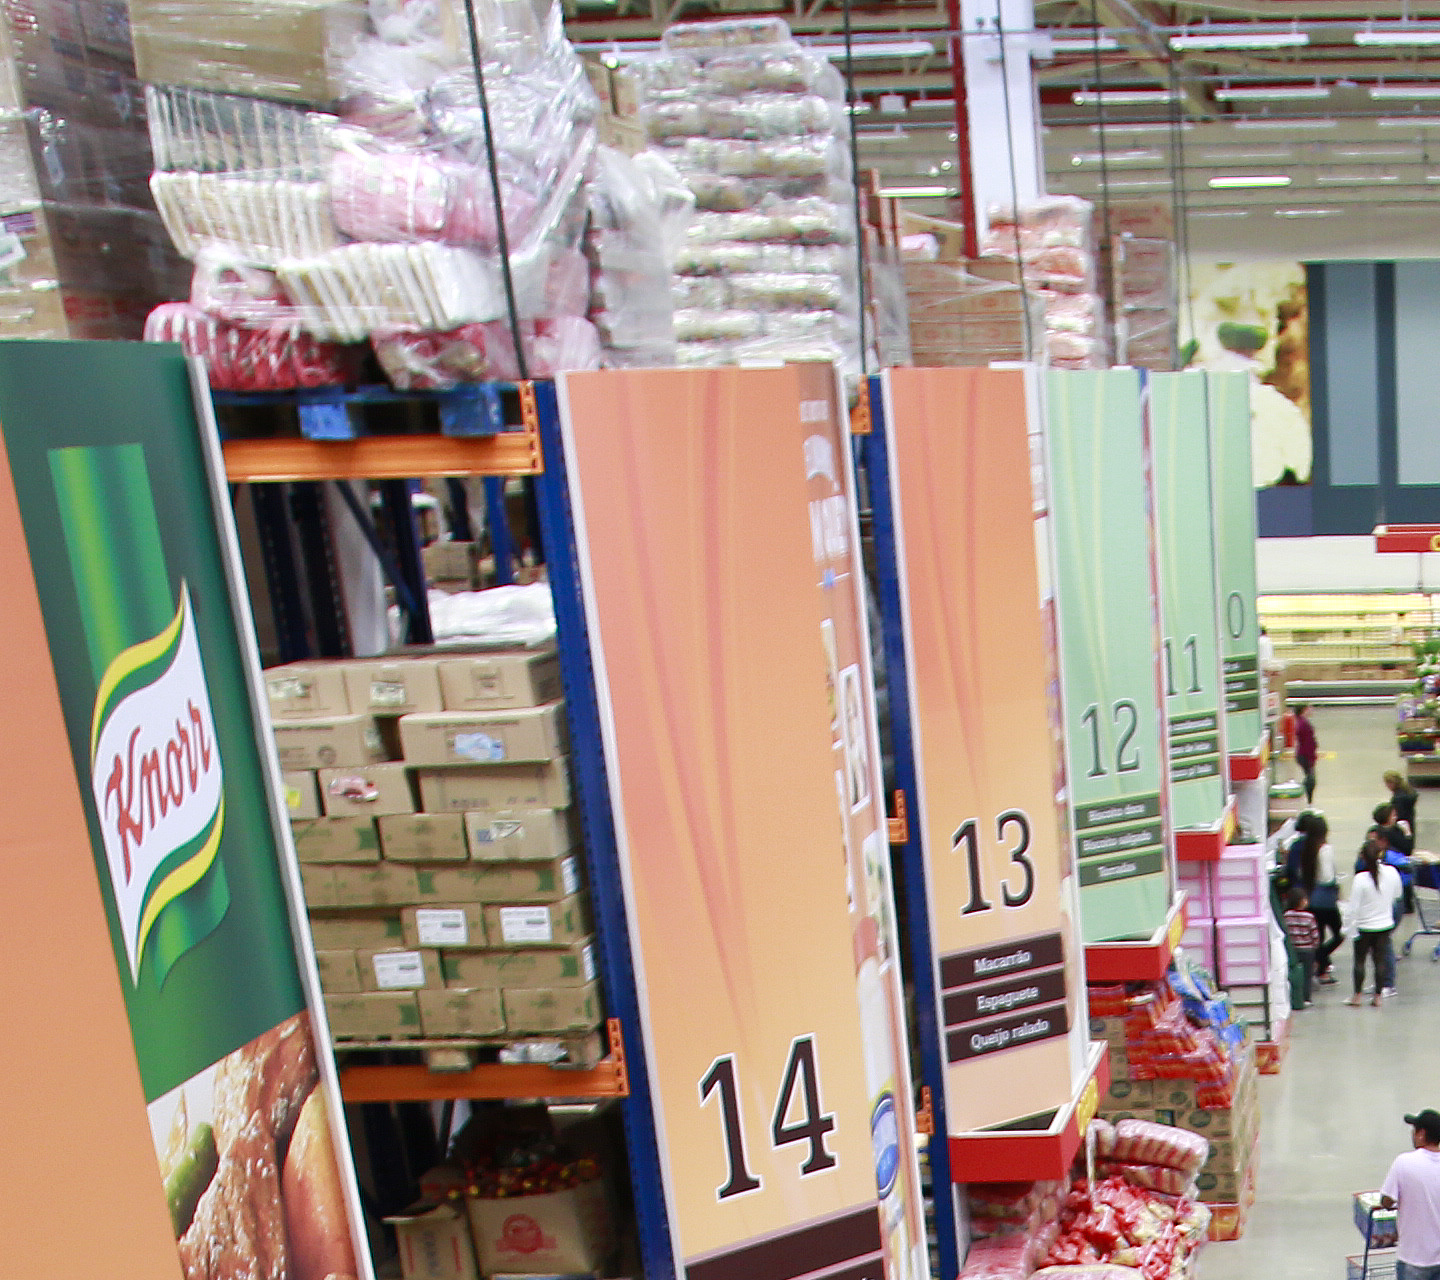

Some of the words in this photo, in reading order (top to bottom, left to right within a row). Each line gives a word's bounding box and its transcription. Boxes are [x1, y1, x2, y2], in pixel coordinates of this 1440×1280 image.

[1080, 697, 1142, 779] 12
[105, 698, 212, 889] Knorr
[951, 808, 1036, 917] 13
[973, 948, 1031, 975] Macarrão
[977, 982, 1040, 1011] Espaguete
[971, 1026, 1011, 1053] Queijo
[1012, 1016, 1050, 1040] ralado
[697, 1032, 840, 1203] 14
